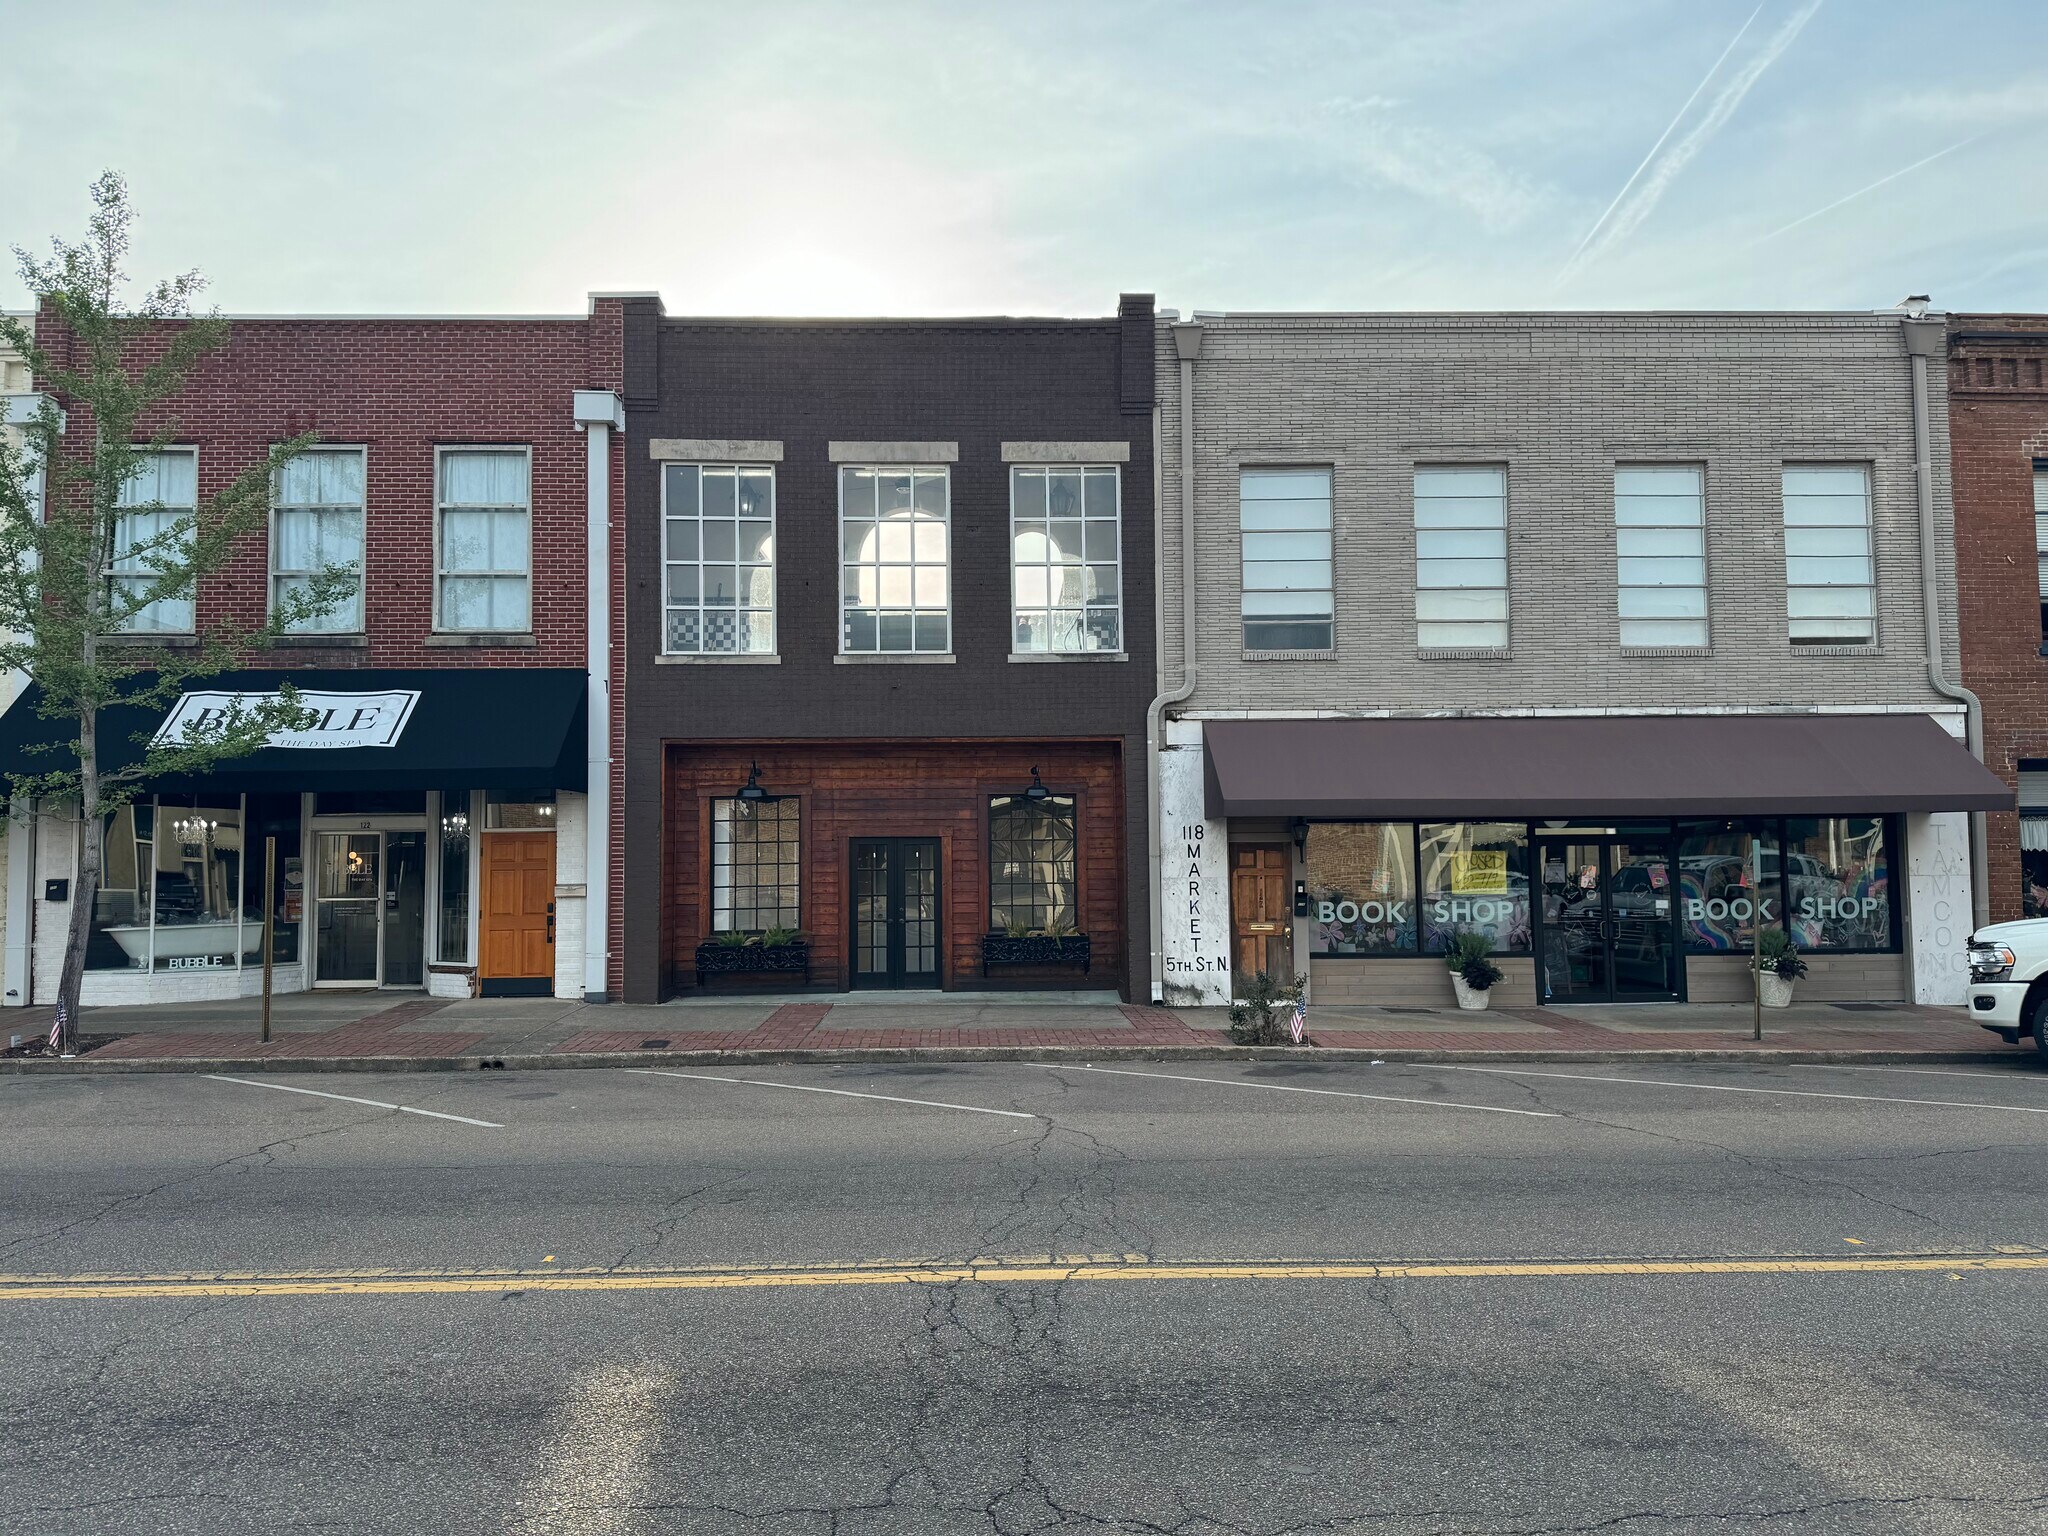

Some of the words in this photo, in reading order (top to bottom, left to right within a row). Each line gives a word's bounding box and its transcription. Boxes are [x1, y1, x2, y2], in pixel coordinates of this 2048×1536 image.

[280, 739, 305, 747] THE
[338, 739, 362, 747] SPA
[1182, 824, 1204, 840] 118
[1187, 843, 1202, 953] MARKET
[1319, 901, 1406, 923] BOOK
[1434, 900, 1514, 922] SHOP
[1688, 898, 1774, 920] BOOK
[1800, 896, 1878, 919] SHOP
[168, 955, 223, 969] BUBBLE
[1217, 956, 1229, 971] N.
